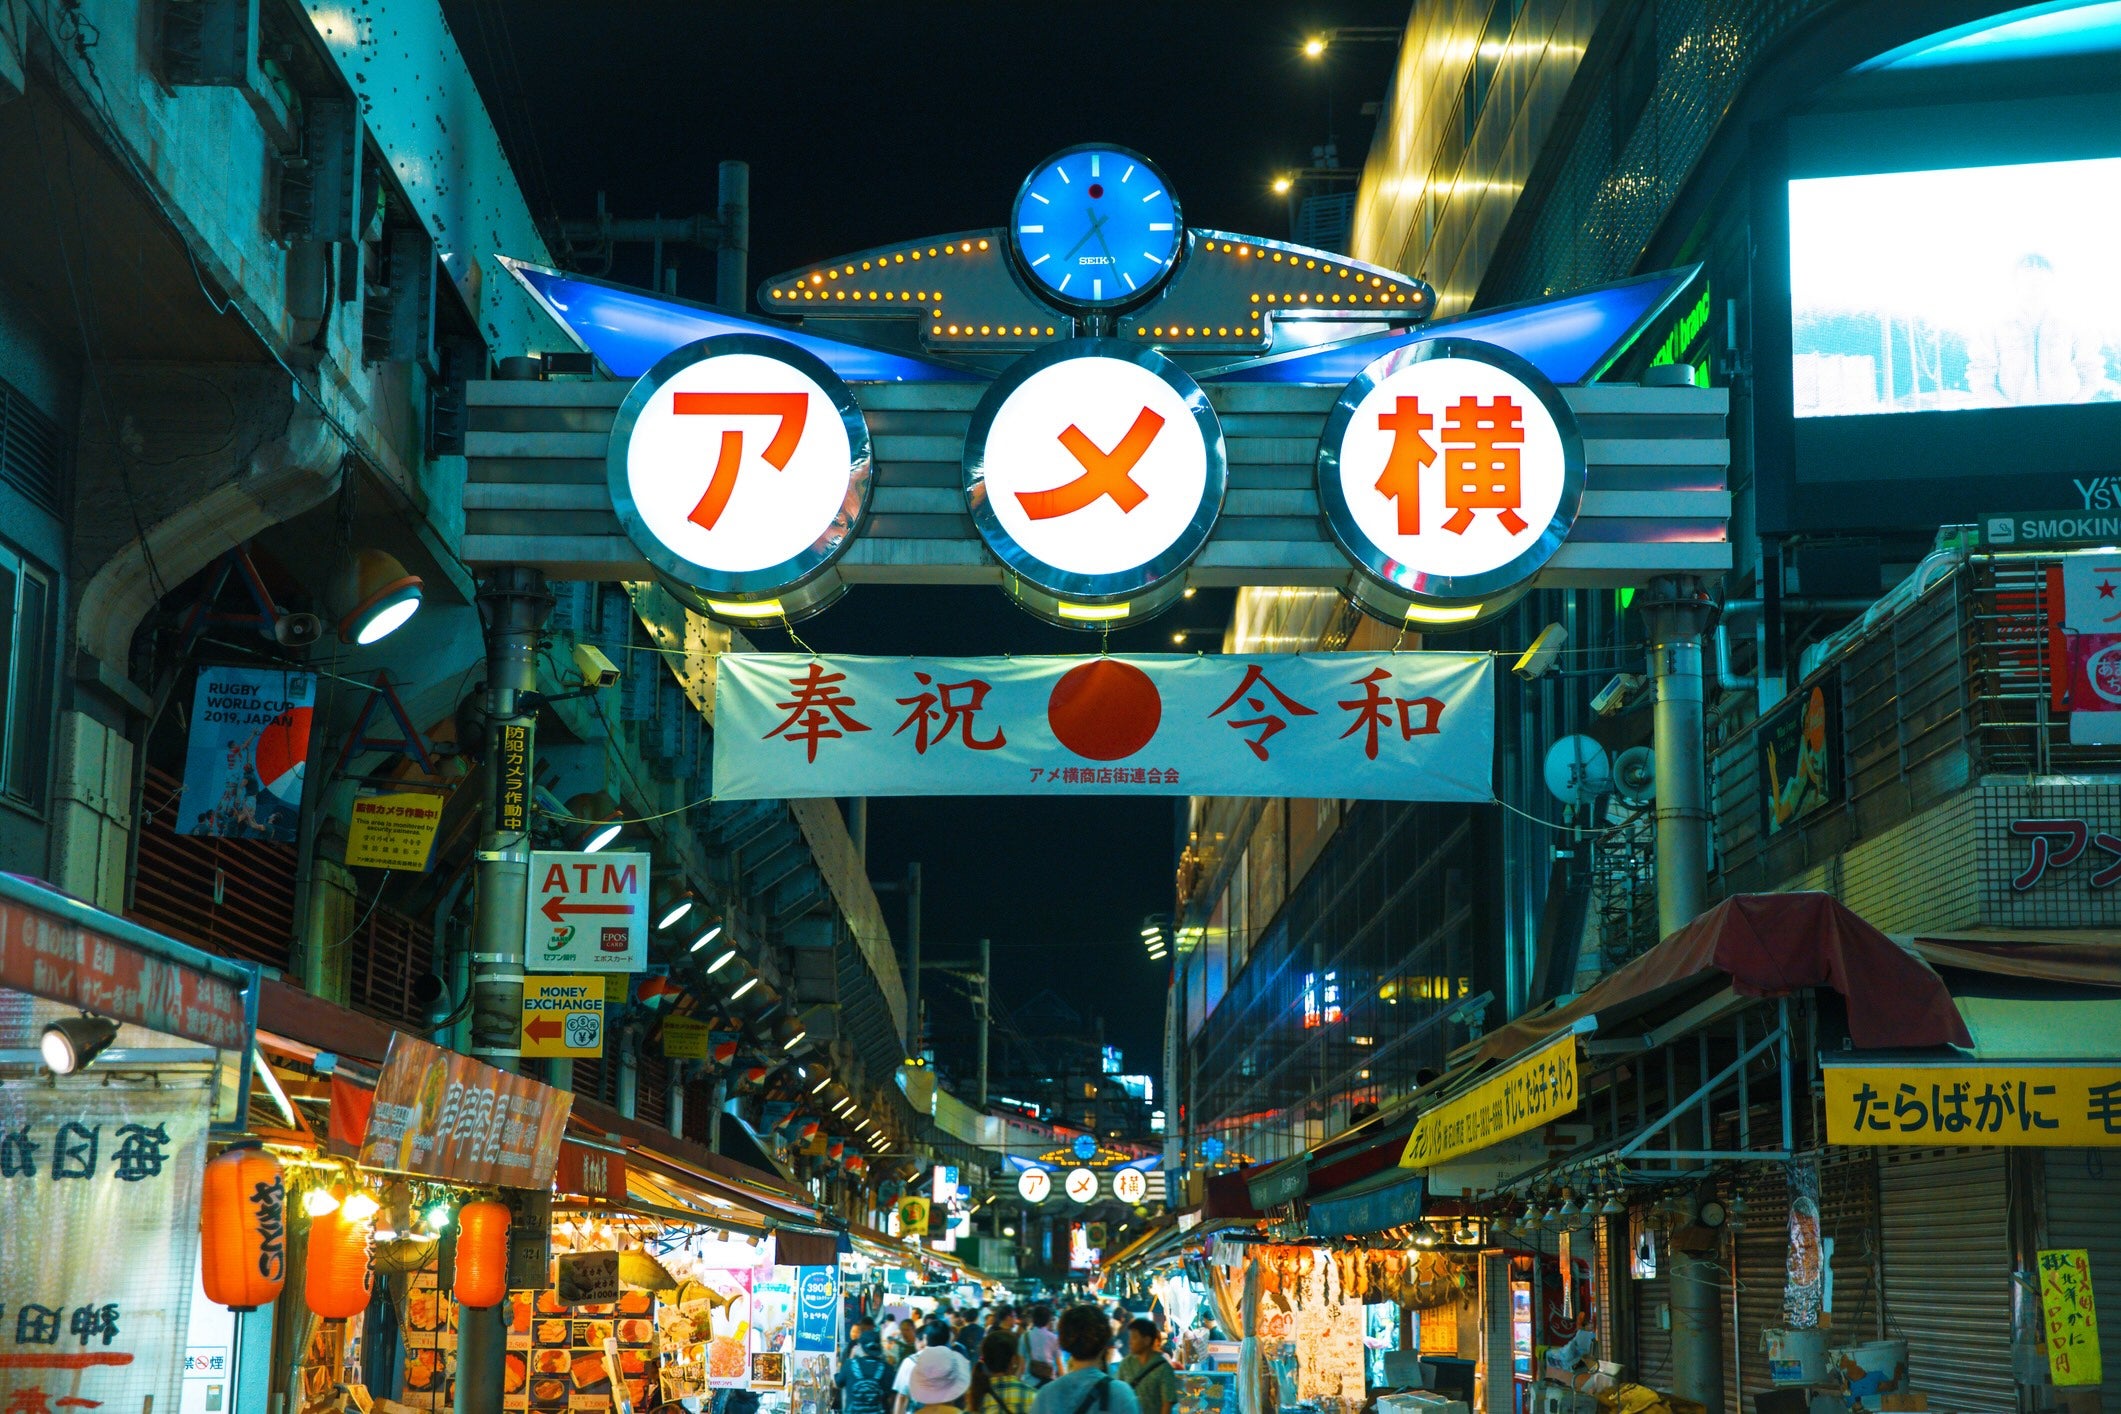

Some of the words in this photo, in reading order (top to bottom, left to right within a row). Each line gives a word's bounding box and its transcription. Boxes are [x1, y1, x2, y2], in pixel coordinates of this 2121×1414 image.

[673, 391, 1529, 537] アメ横
[2022, 517, 2121, 539] SMOKIN
[208, 682, 260, 696] RUGBY
[207, 697, 261, 711] WORLD
[264, 700, 295, 712] CUP
[244, 714, 293, 727] JAPAN
[762, 662, 1007, 764] 奉祝
[1207, 664, 1446, 761] 令和
[504, 725, 525, 830] 防犯カメラ作動中
[1029, 766, 1180, 786] アメ横商店街連合会
[541, 863, 637, 894] ATM
[603, 933, 627, 942] EPOS
[543, 954, 576, 962] セブン銀行
[594, 955, 633, 963] エポスカード
[540, 987, 588, 997] MONEY
[524, 999, 602, 1010] EXCHANGE
[1853, 1080, 2060, 1133] たらばがに
[1026, 1175, 1139, 1196] アメ横
[209, 1356, 224, 1370] 煙
